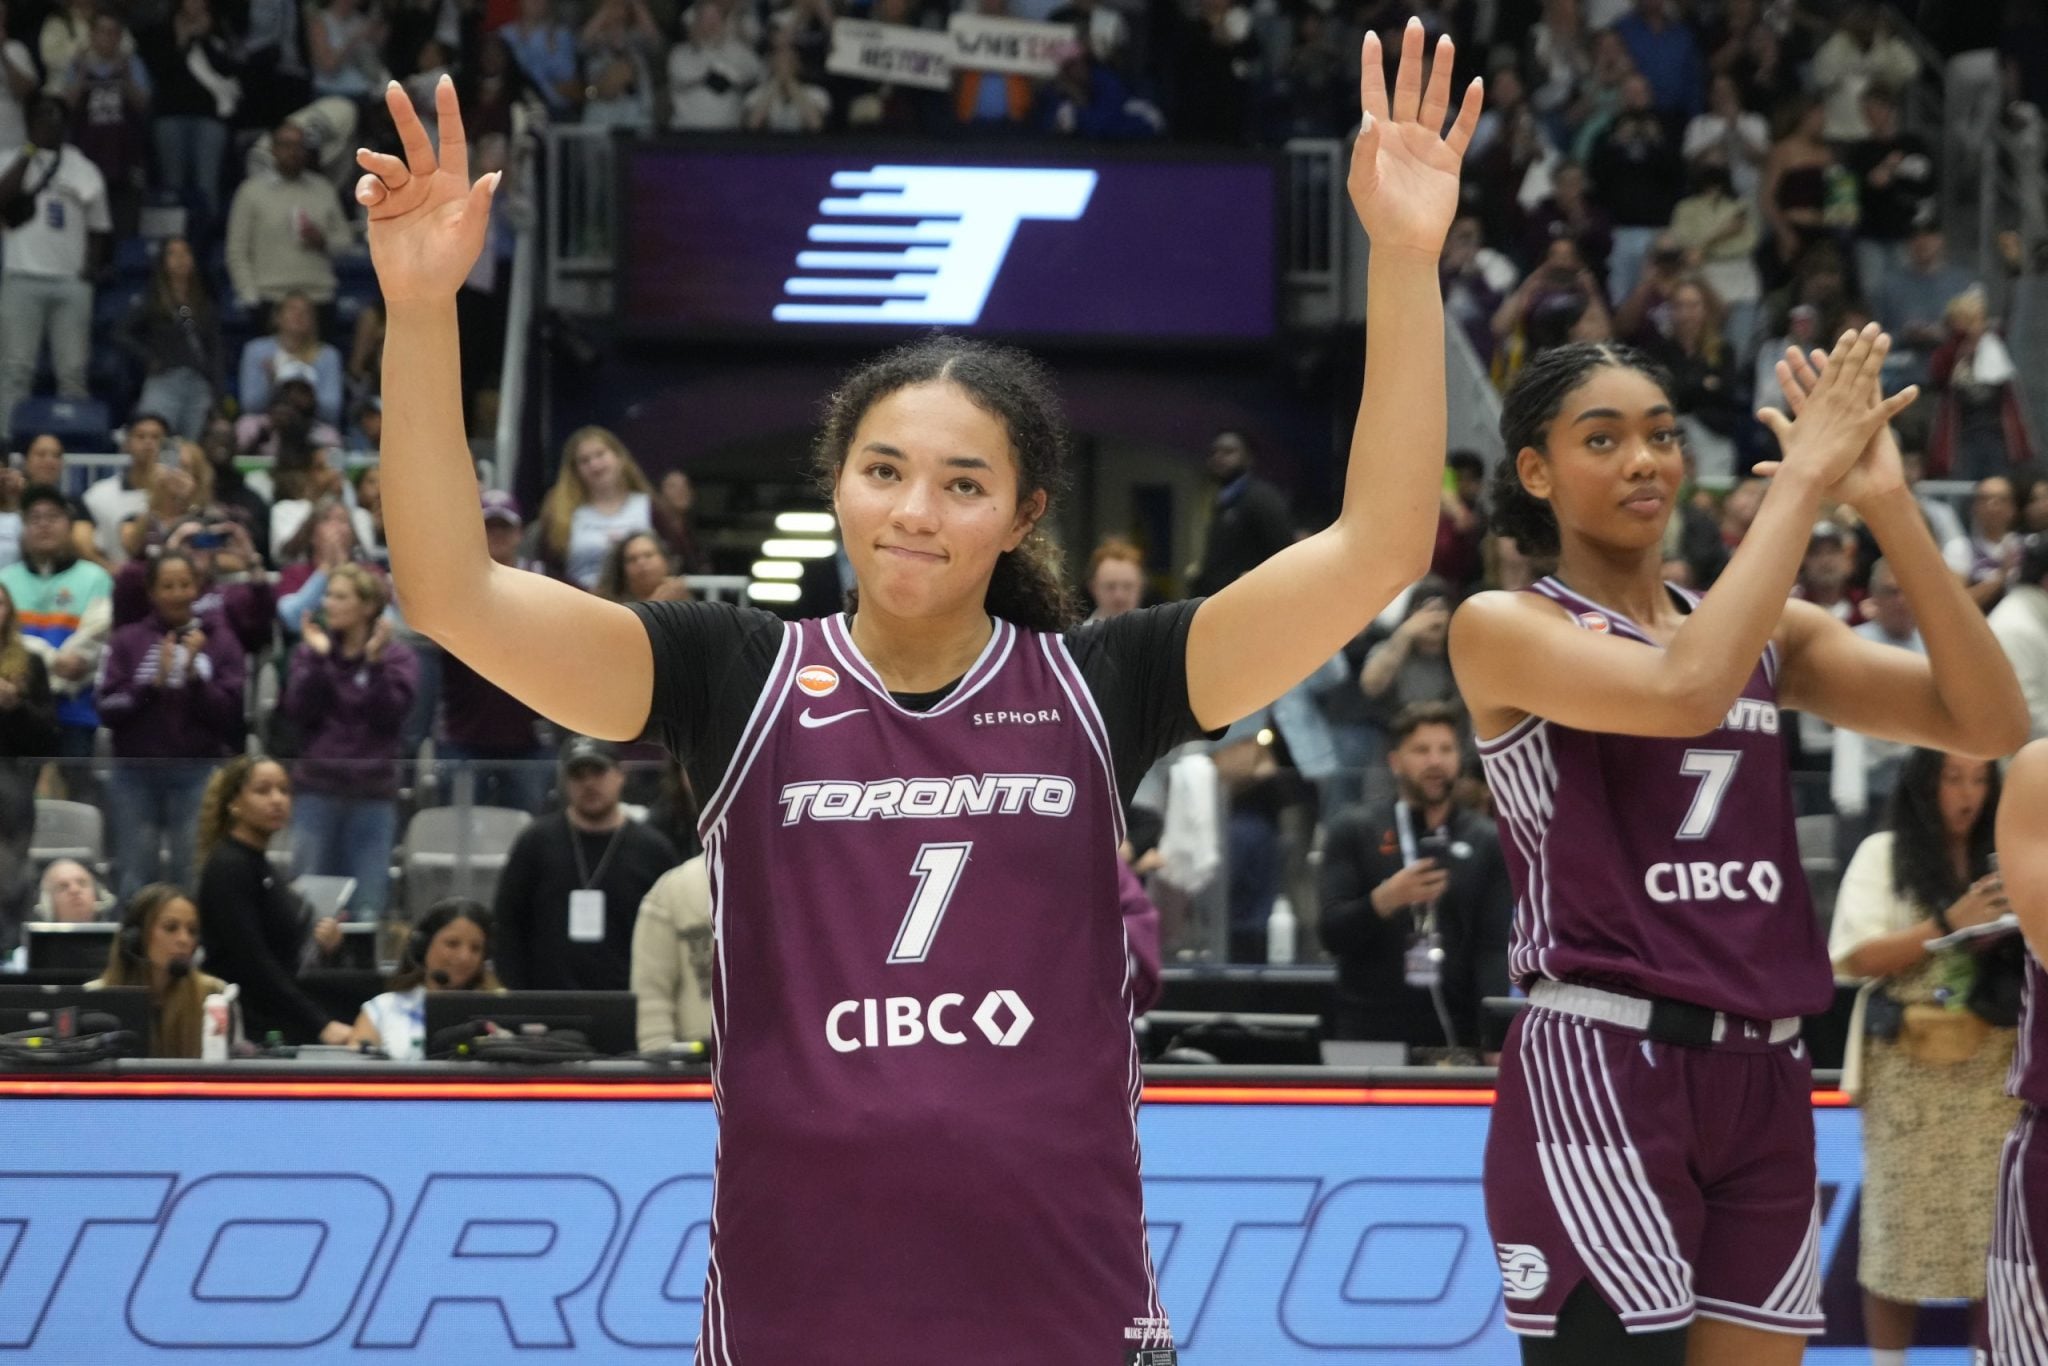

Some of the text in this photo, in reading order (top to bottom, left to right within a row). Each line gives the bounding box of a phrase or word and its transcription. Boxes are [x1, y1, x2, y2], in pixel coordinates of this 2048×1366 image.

[772, 164, 1098, 326] T
[973, 709, 1061, 725] SEPHORA
[781, 773, 1076, 827] TORONTO
[1674, 748, 1743, 840] 7
[886, 841, 974, 964] 1
[1645, 861, 1747, 904] CIBC
[826, 993, 968, 1052] CIBC
